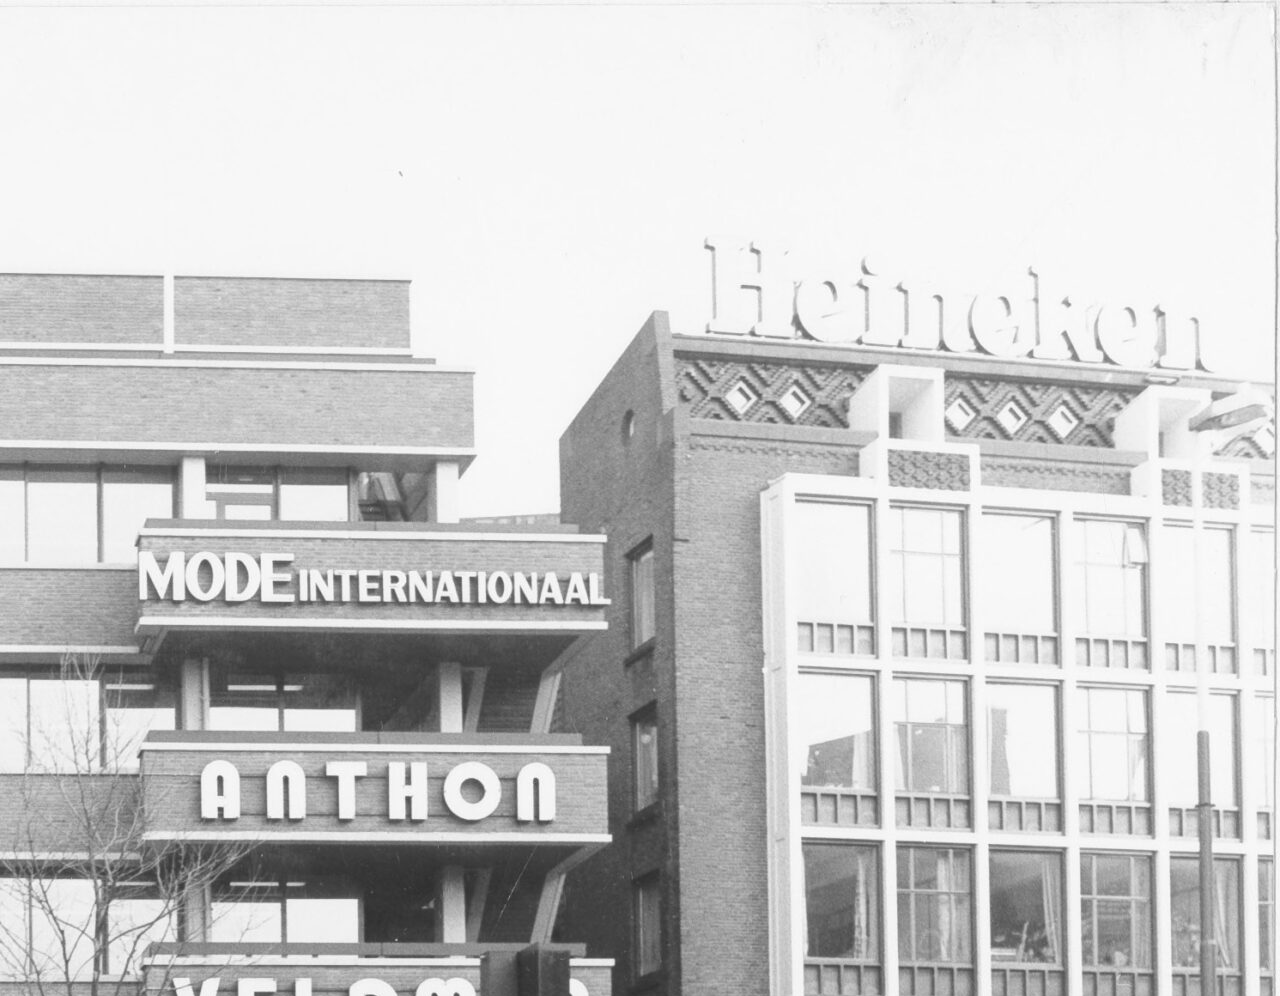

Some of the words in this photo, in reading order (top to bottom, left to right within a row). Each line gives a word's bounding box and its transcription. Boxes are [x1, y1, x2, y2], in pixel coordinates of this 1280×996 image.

[704, 236, 1214, 373] Heineken
[139, 551, 295, 603] MODE
[299, 569, 611, 605] INTERNATIONAAL
[200, 759, 556, 821] ANTHON
